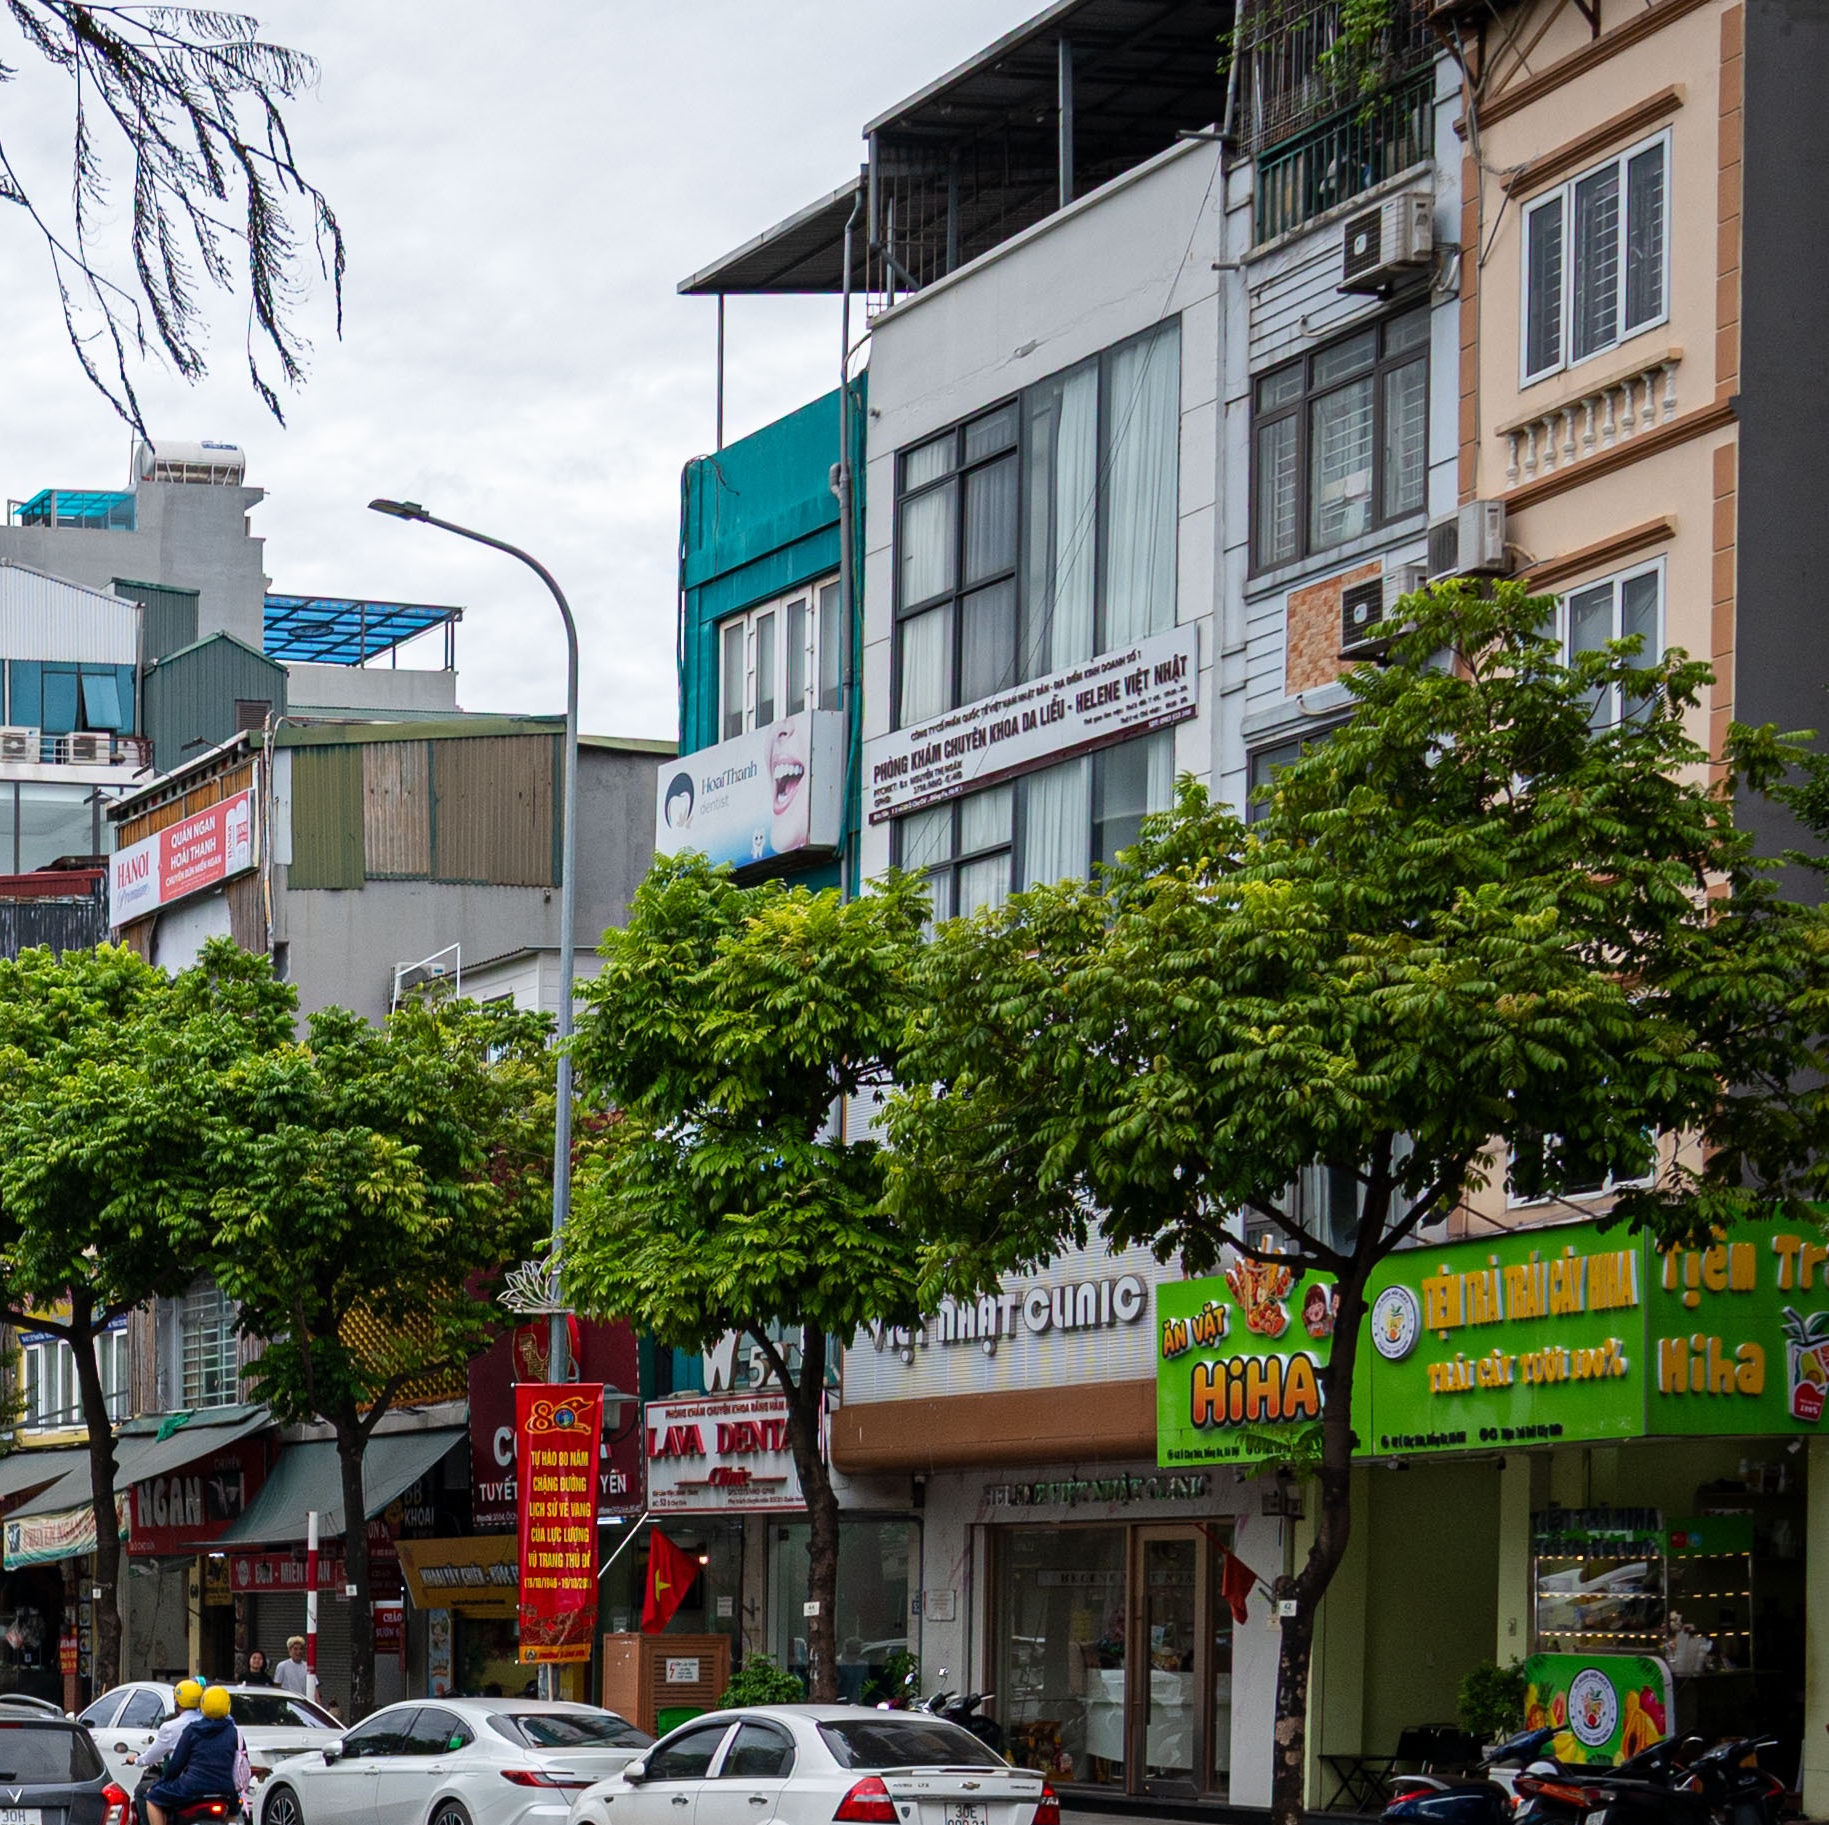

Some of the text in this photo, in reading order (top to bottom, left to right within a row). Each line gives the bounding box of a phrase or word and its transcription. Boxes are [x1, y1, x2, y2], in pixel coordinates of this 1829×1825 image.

[873, 755, 908, 783] PHÒNG
[910, 742, 942, 771] KHÁM
[944, 727, 987, 759] CHUYÊN
[989, 716, 1019, 744] KHOA
[1022, 709, 1038, 732] DA
[1040, 693, 1065, 725] LIỄU
[1075, 680, 1120, 714] HELENE
[1124, 667, 1150, 696] VIỆT
[1154, 653, 1188, 685] NHẬT
[171, 825, 192, 848] QUÁN
[193, 814, 216, 838] NGAN
[190, 836, 217, 861] THANH
[117, 851, 150, 889] HANOI
[1771, 1233, 1829, 1290] Tr
[1464, 1254, 1503, 1325] TRÀ
[1504, 1250, 1549, 1319] TRÁI
[1550, 1246, 1588, 1315] CÂY
[1162, 1301, 1227, 1359] ĂN VẶT
[1427, 1352, 1476, 1393] TRÁI
[1477, 1348, 1518, 1388] CÂY
[1571, 1337, 1628, 1380] 100%
[1658, 1333, 1765, 1395] Hiha
[647, 1423, 707, 1458] LAVA
[530, 1448, 589, 1468] TỰ HÀO 80 NĂM
[532, 1474, 587, 1493] CHẶNG ĐƯỜNG
[136, 1476, 205, 1528] NGAN
[405, 1506, 435, 1527] KHOAI
[528, 1502, 546, 1519] LỊCH
[546, 1498, 559, 1517] SỬ
[570, 1501, 591, 1518] VANG
[530, 1523, 546, 1543] CỦA
[546, 1525, 562, 1544] LỰC
[538, 1552, 564, 1569] TRANG
[564, 1547, 580, 1568] THỦ
[2, 1809, 27, 1823] 30H
[955, 1804, 977, 1819] 30E
